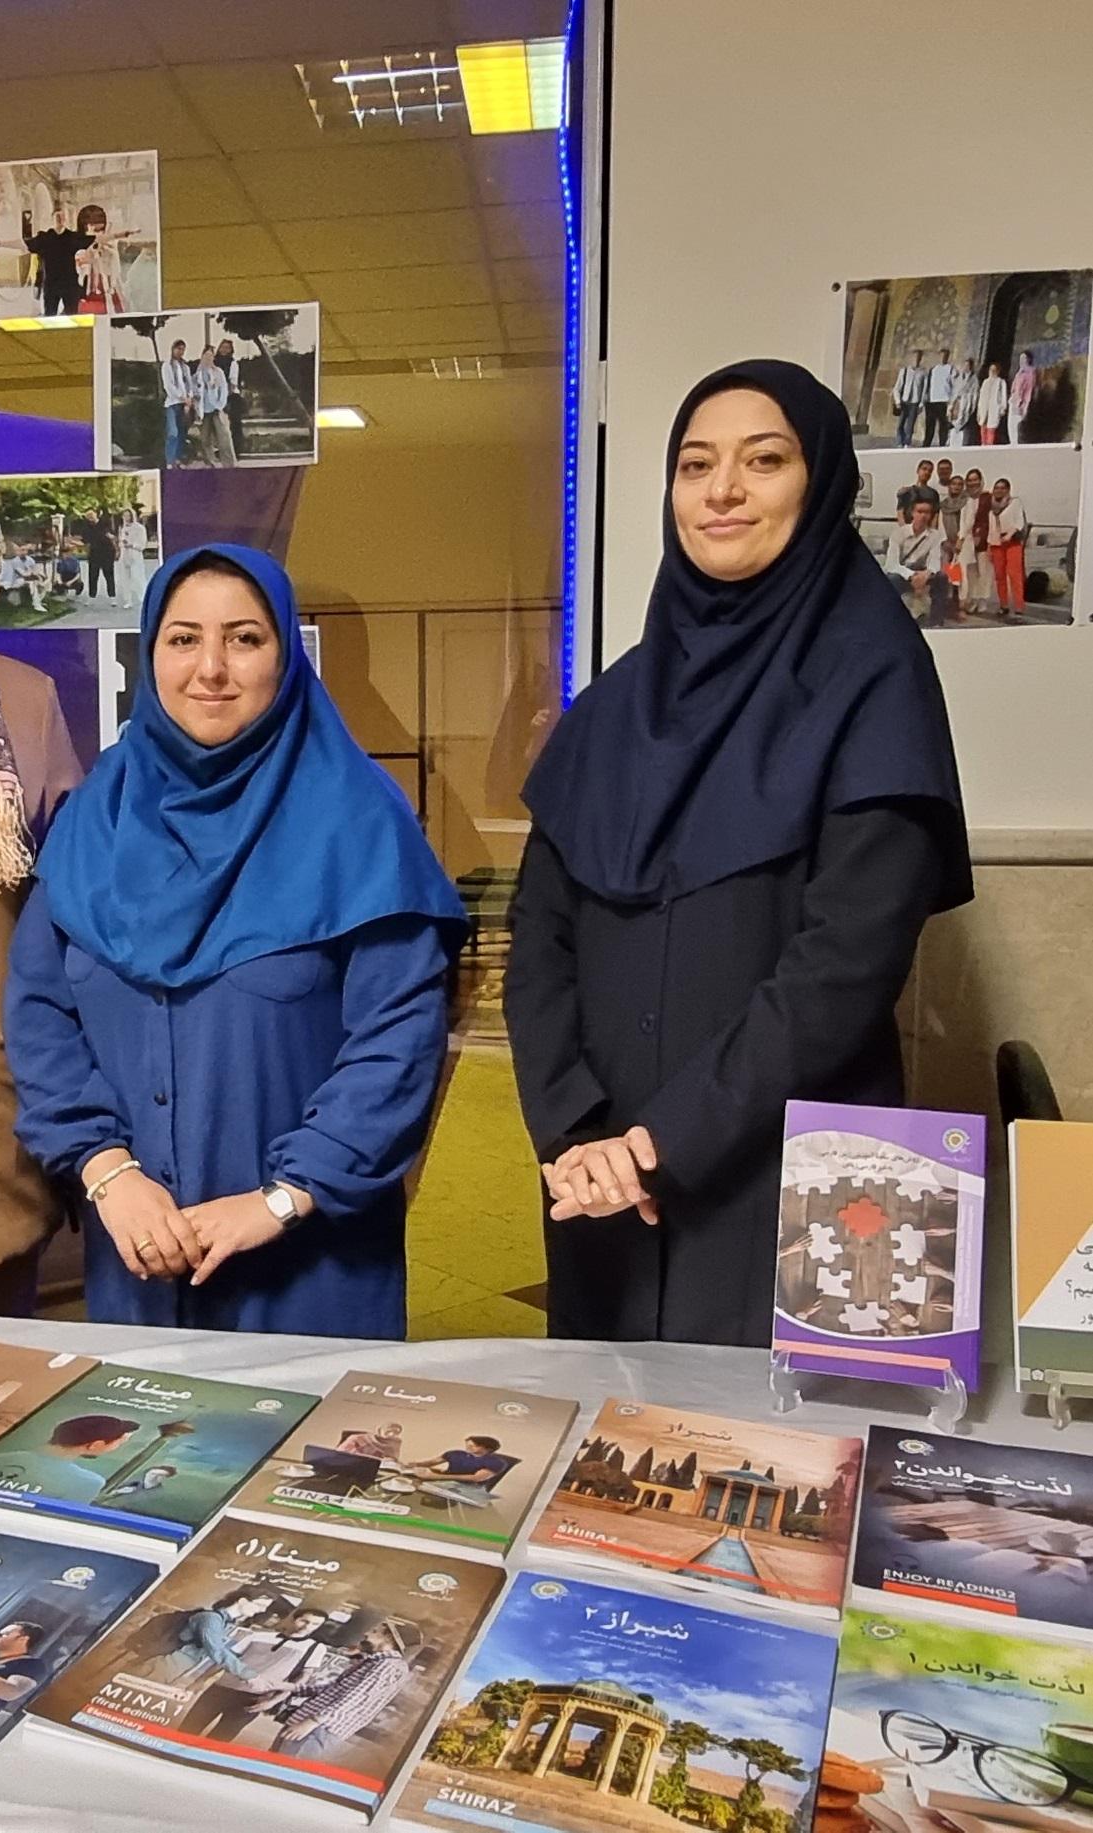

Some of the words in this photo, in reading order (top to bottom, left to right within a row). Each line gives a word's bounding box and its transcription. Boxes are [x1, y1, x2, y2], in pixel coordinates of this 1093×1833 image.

[383, 1385, 437, 1404] مینا
[659, 1422, 733, 1443] شیراز
[600, 1611, 689, 1641] شیراز
[924, 1660, 1020, 1682] خواندن
[86, 1706, 145, 1731] Elementary
[90, 1695, 122, 1713] (first
[122, 1705, 172, 1727] edition)
[436, 1787, 517, 1817] SHIRAZ
